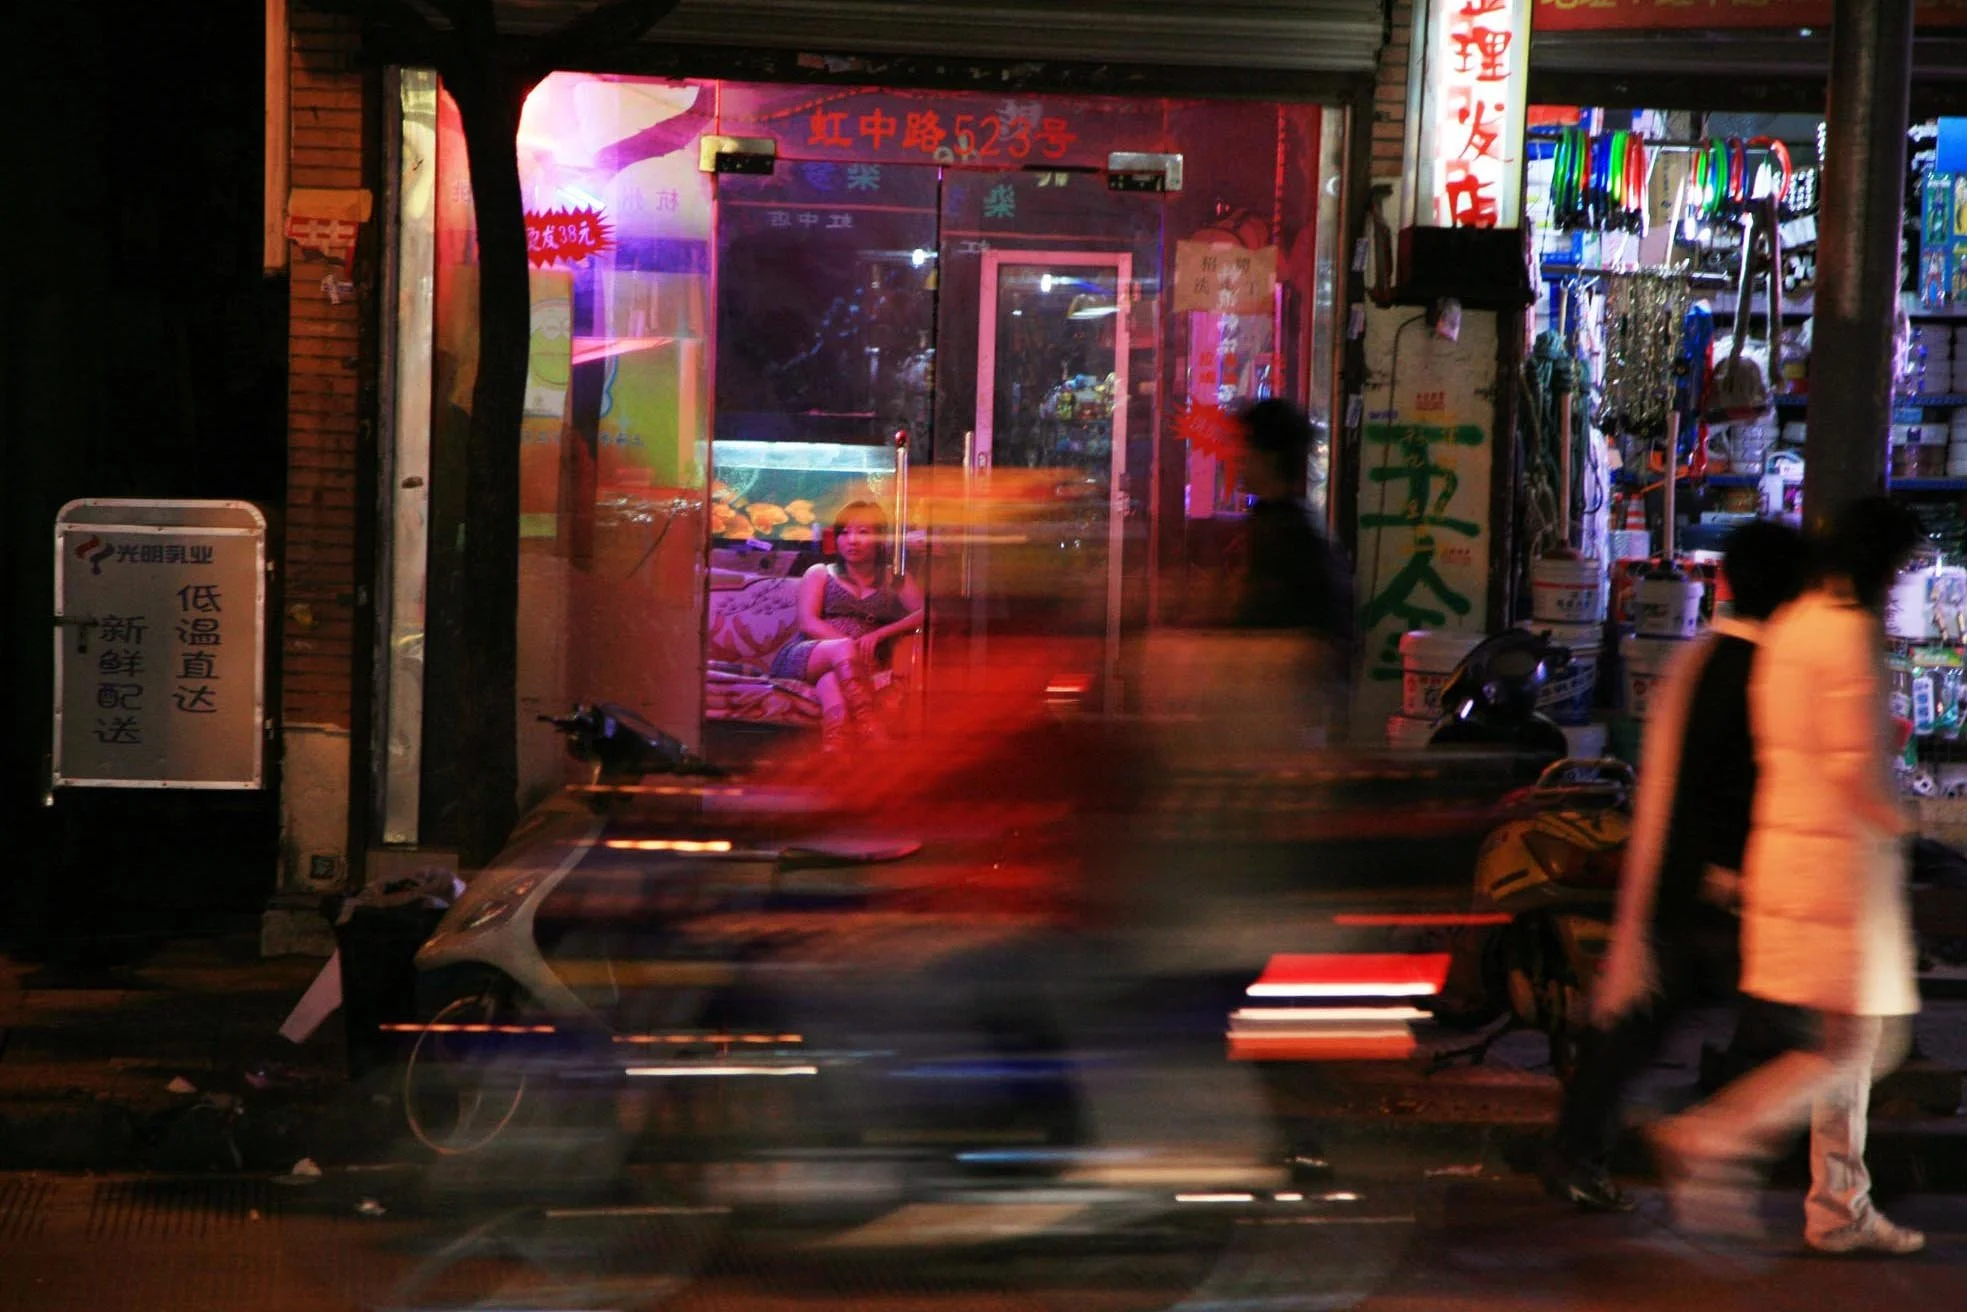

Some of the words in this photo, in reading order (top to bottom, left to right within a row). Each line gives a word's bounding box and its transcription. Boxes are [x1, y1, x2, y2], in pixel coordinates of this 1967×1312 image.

[807, 107, 1076, 159] 虹中路523号
[1446, 0, 1514, 228] 理发店
[116, 543, 214, 565] 光明乳业
[1359, 423, 1484, 681] 五金
[93, 614, 147, 745] 新鲜配送
[173, 584, 222, 713] 低温直达
